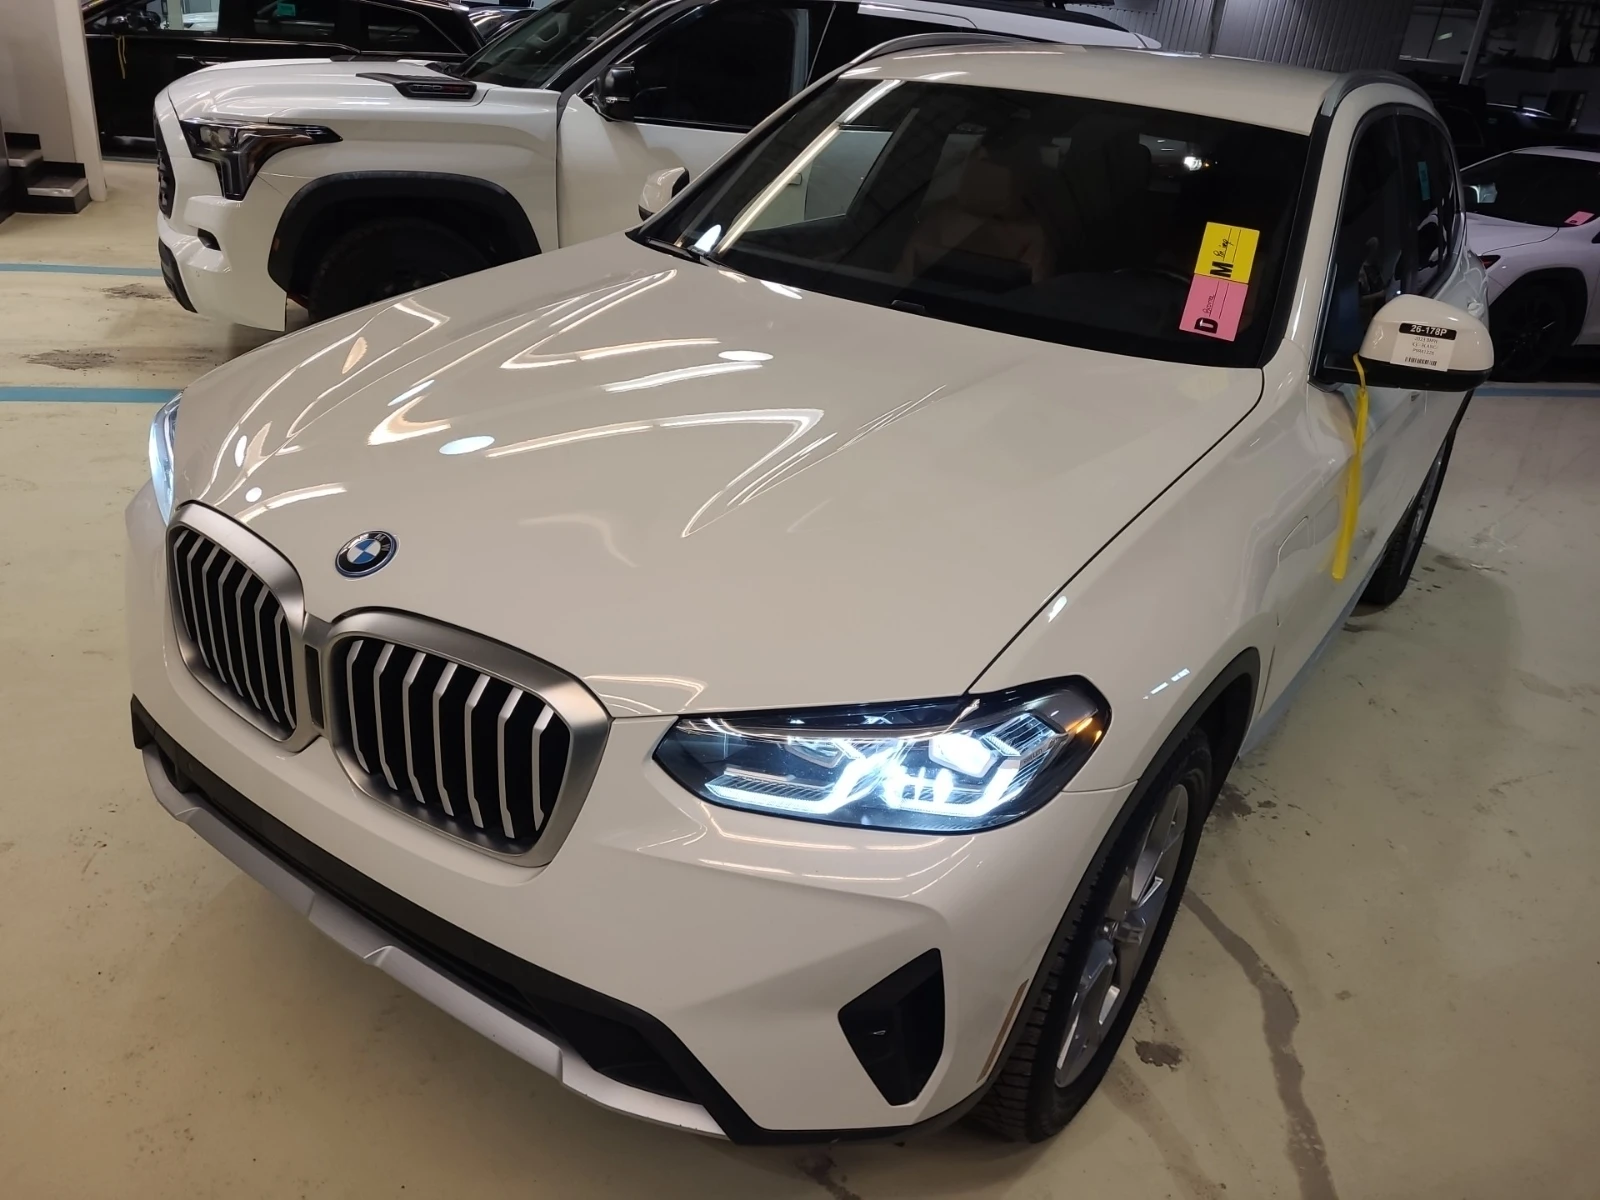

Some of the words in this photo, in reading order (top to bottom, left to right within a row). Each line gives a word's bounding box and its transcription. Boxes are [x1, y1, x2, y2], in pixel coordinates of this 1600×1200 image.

[1210, 261, 1233, 278] M
[1194, 317, 1218, 334] D
[1410, 325, 1447, 336] 26-178P
